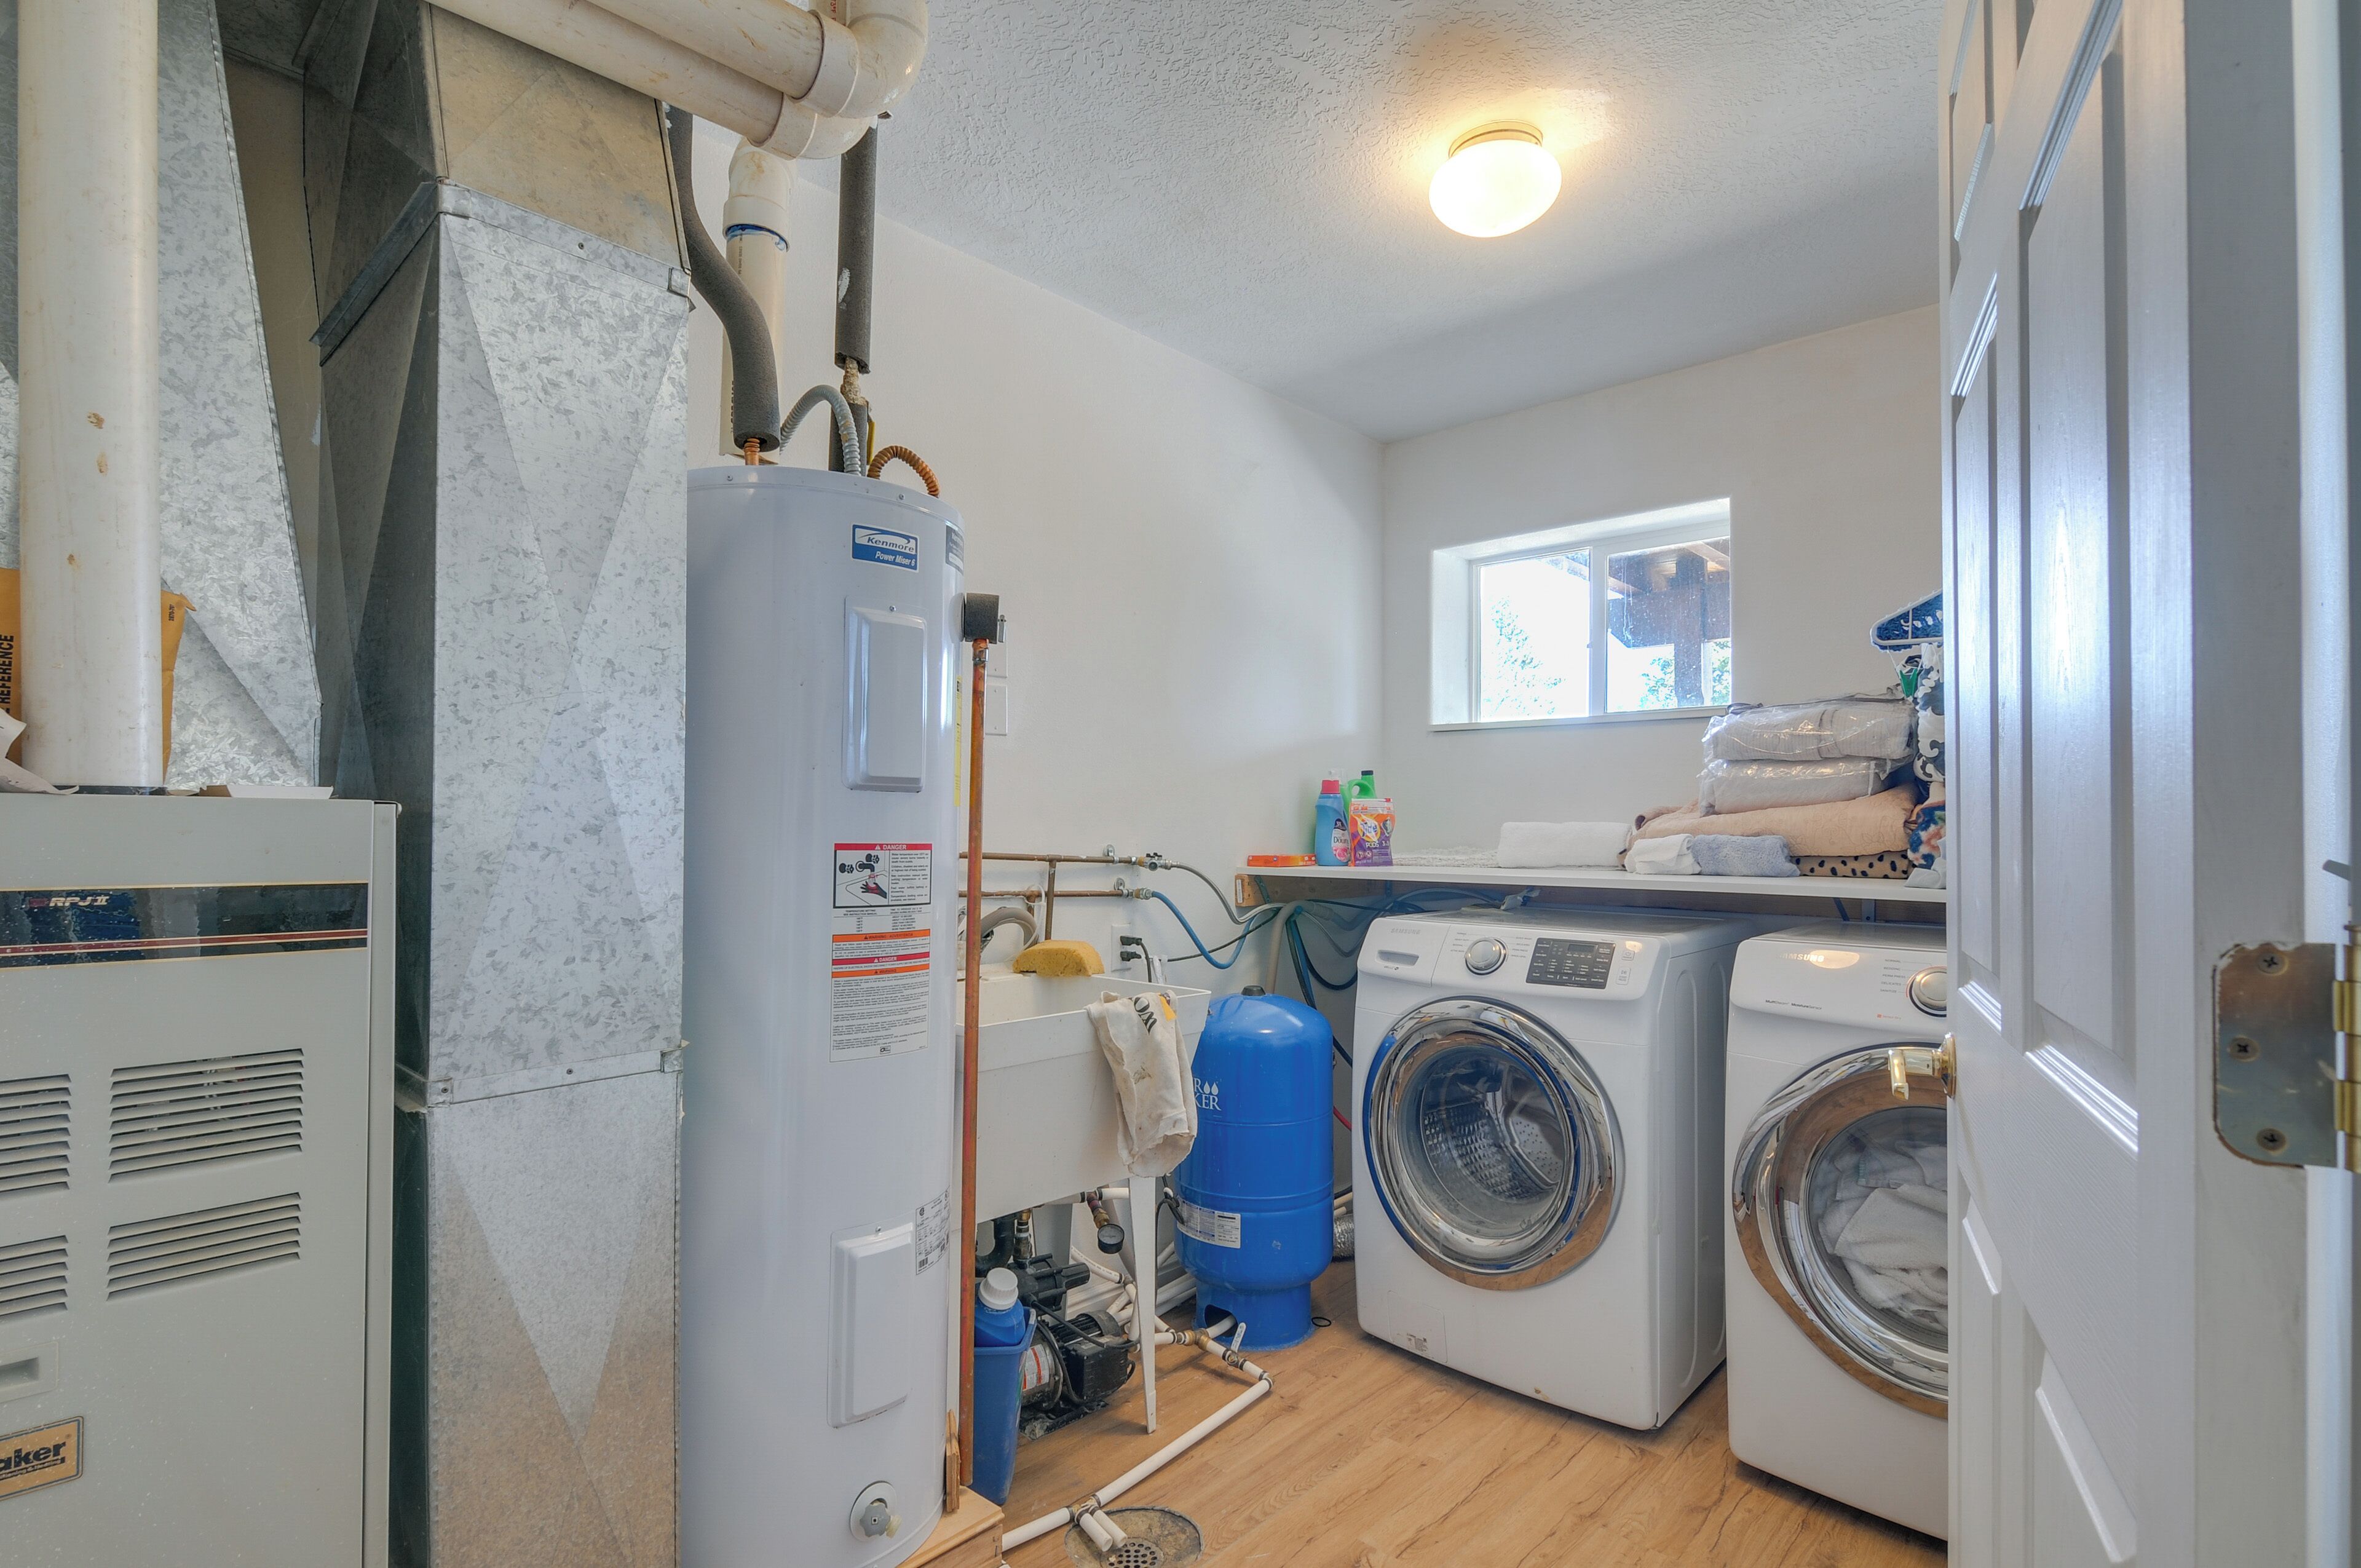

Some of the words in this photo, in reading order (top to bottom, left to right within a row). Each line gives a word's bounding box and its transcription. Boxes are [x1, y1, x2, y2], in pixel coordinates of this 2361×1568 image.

[867, 537, 914, 552] Kenmore
[875, 551, 896, 561] Power
[895, 555, 911, 565] Miser
[0, 635, 14, 704] REFERENCE
[49, 896, 92, 906] RPJ
